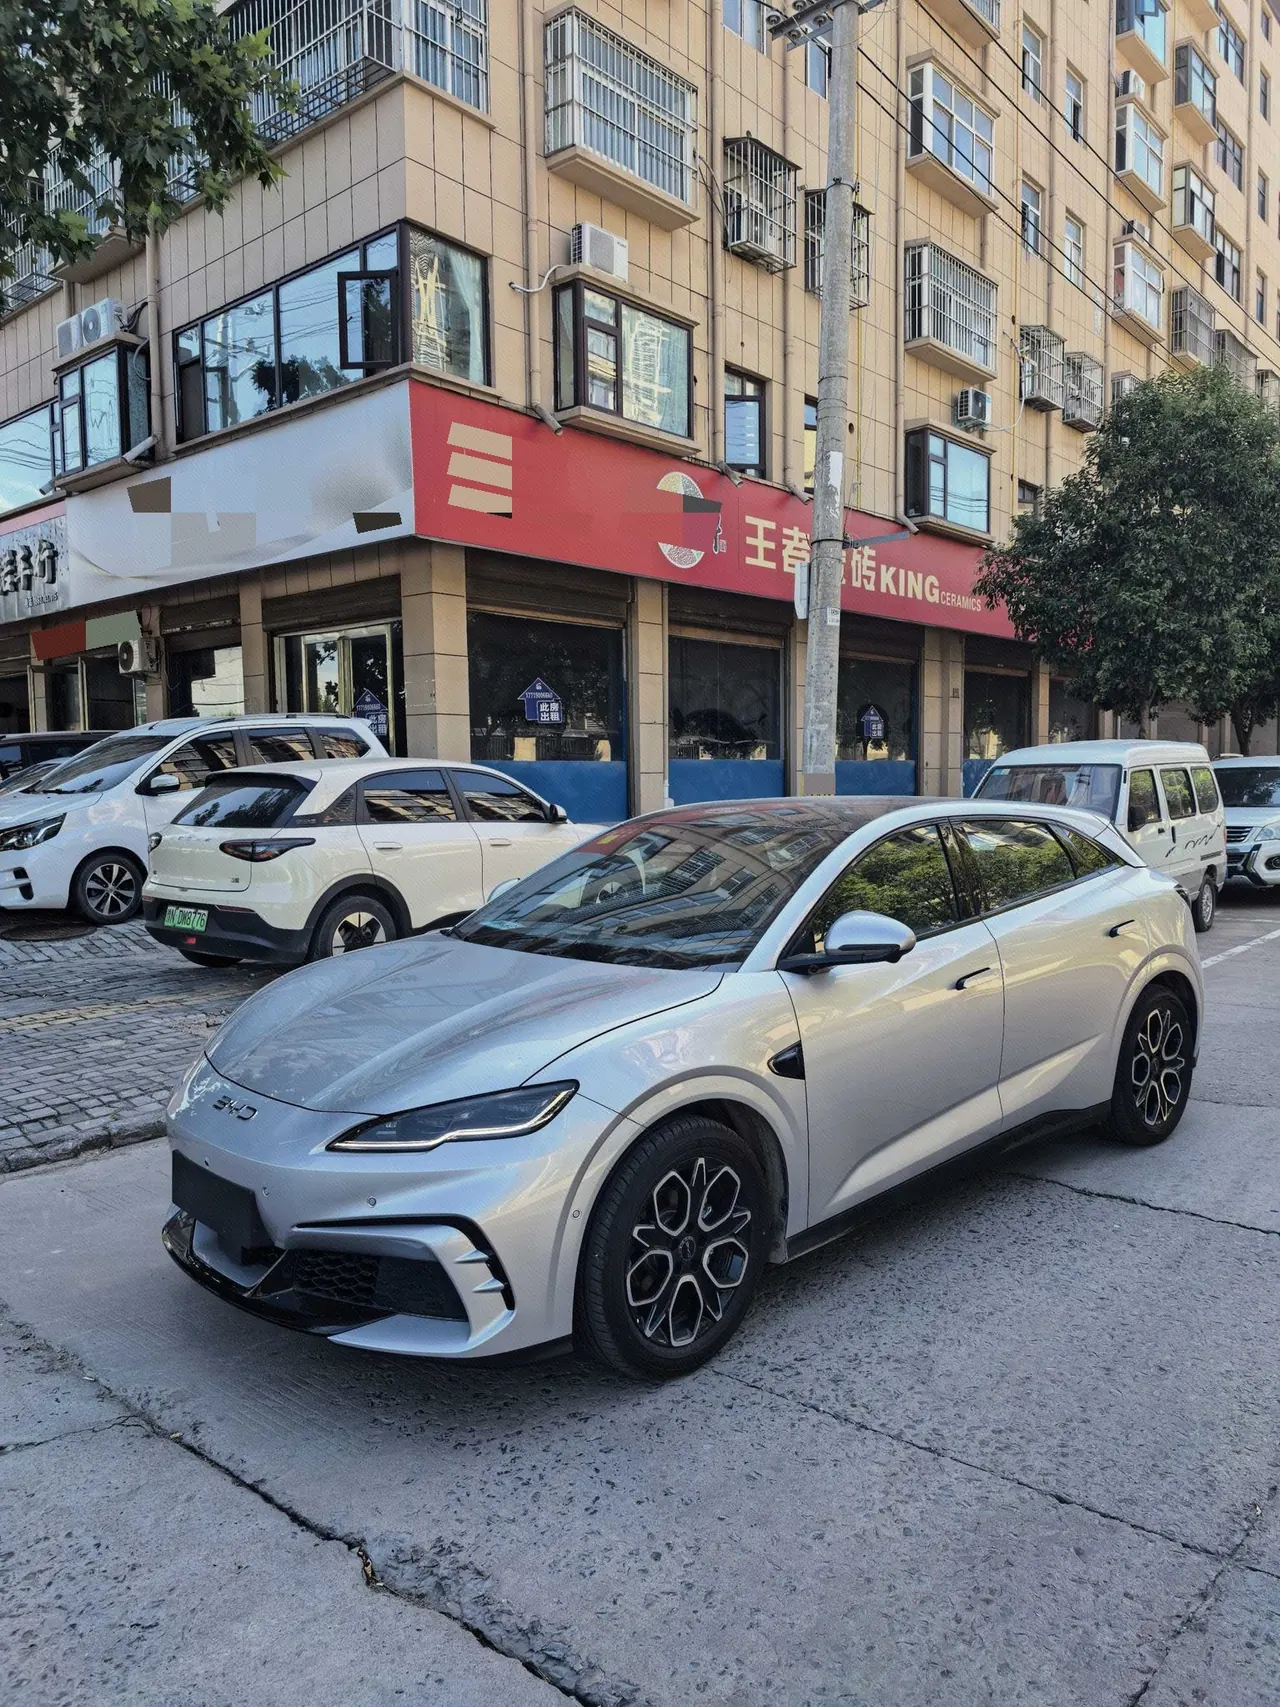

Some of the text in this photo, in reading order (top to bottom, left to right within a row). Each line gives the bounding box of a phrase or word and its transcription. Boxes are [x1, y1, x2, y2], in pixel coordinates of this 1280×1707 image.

[745, 515, 982, 612] 王者砖 KING CERAMICS
[539, 702, 559, 712] 此房
[540, 712, 560, 721] 出租
